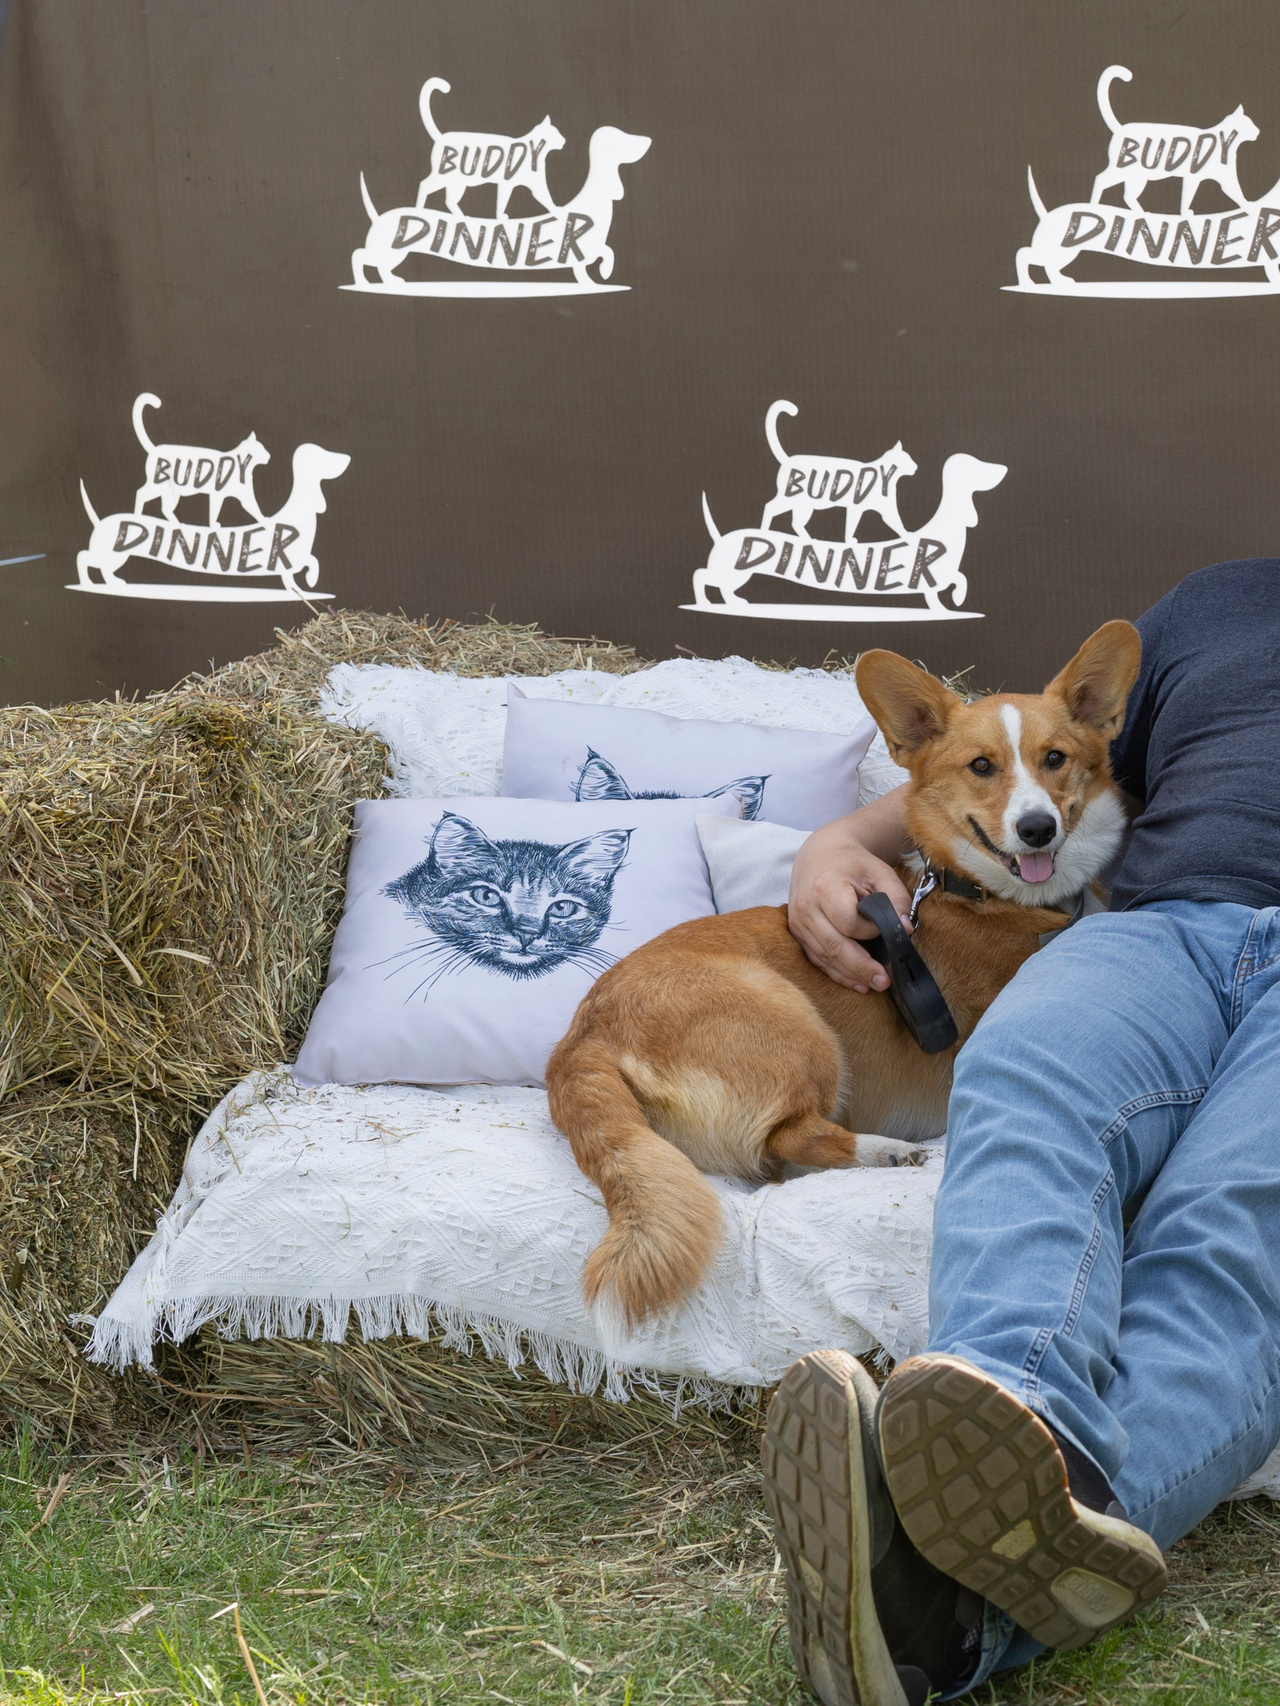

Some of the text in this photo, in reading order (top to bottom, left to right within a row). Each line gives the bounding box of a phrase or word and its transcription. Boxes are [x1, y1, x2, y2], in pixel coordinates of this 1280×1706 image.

[439, 139, 546, 181] BUDDY
[1117, 129, 1238, 174] BUDDY
[392, 213, 594, 266] DINNER
[153, 452, 252, 491] BUDDY
[785, 463, 901, 505] BUDDY
[113, 523, 300, 571] DINNER
[735, 537, 947, 590] DINNER
